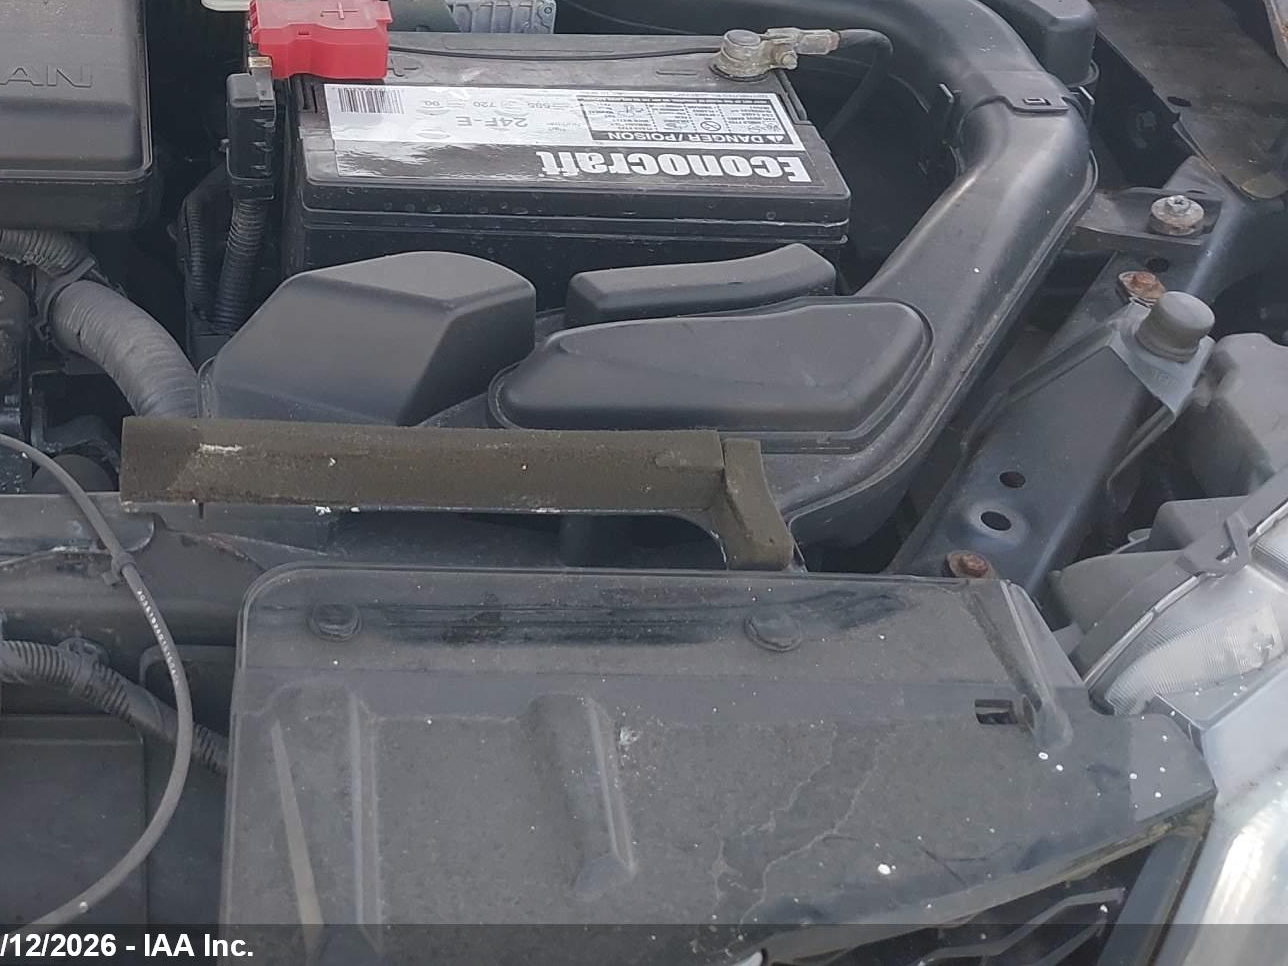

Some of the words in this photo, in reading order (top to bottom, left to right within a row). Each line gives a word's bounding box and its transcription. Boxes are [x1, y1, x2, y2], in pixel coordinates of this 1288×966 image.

[455, 116, 529, 128] 24F-E
[688, 132, 763, 144] DANGER
[536, 150, 812, 183] Econocraft
